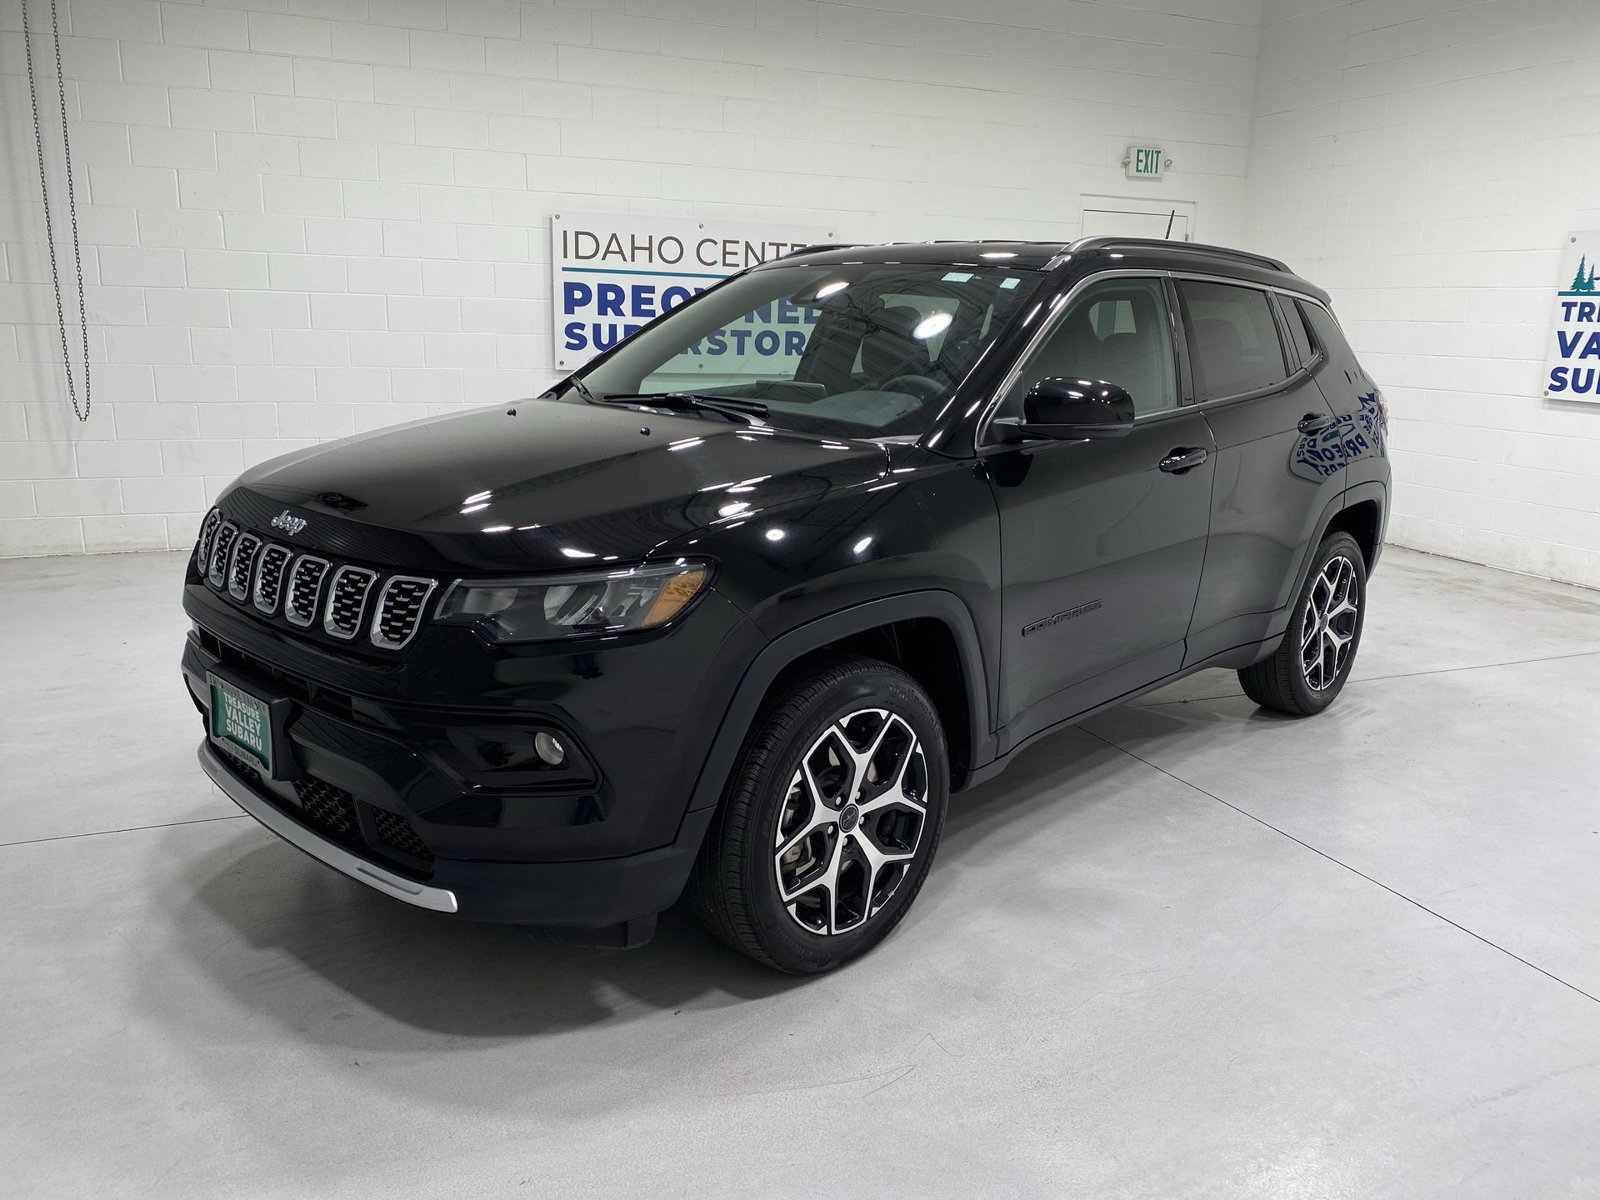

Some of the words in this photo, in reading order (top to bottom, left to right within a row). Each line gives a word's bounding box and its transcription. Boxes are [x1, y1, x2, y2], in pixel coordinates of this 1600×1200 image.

[1136, 149, 1161, 174] EXIT
[562, 230, 684, 265] IDAHO
[696, 238, 807, 268] CENT
[1561, 301, 1600, 323] TR
[1548, 366, 1600, 395] SU
[270, 509, 308, 537] Jeep
[223, 692, 261, 722] TREASURE
[224, 703, 262, 737] VALLEY
[226, 718, 262, 751] SUBARU
